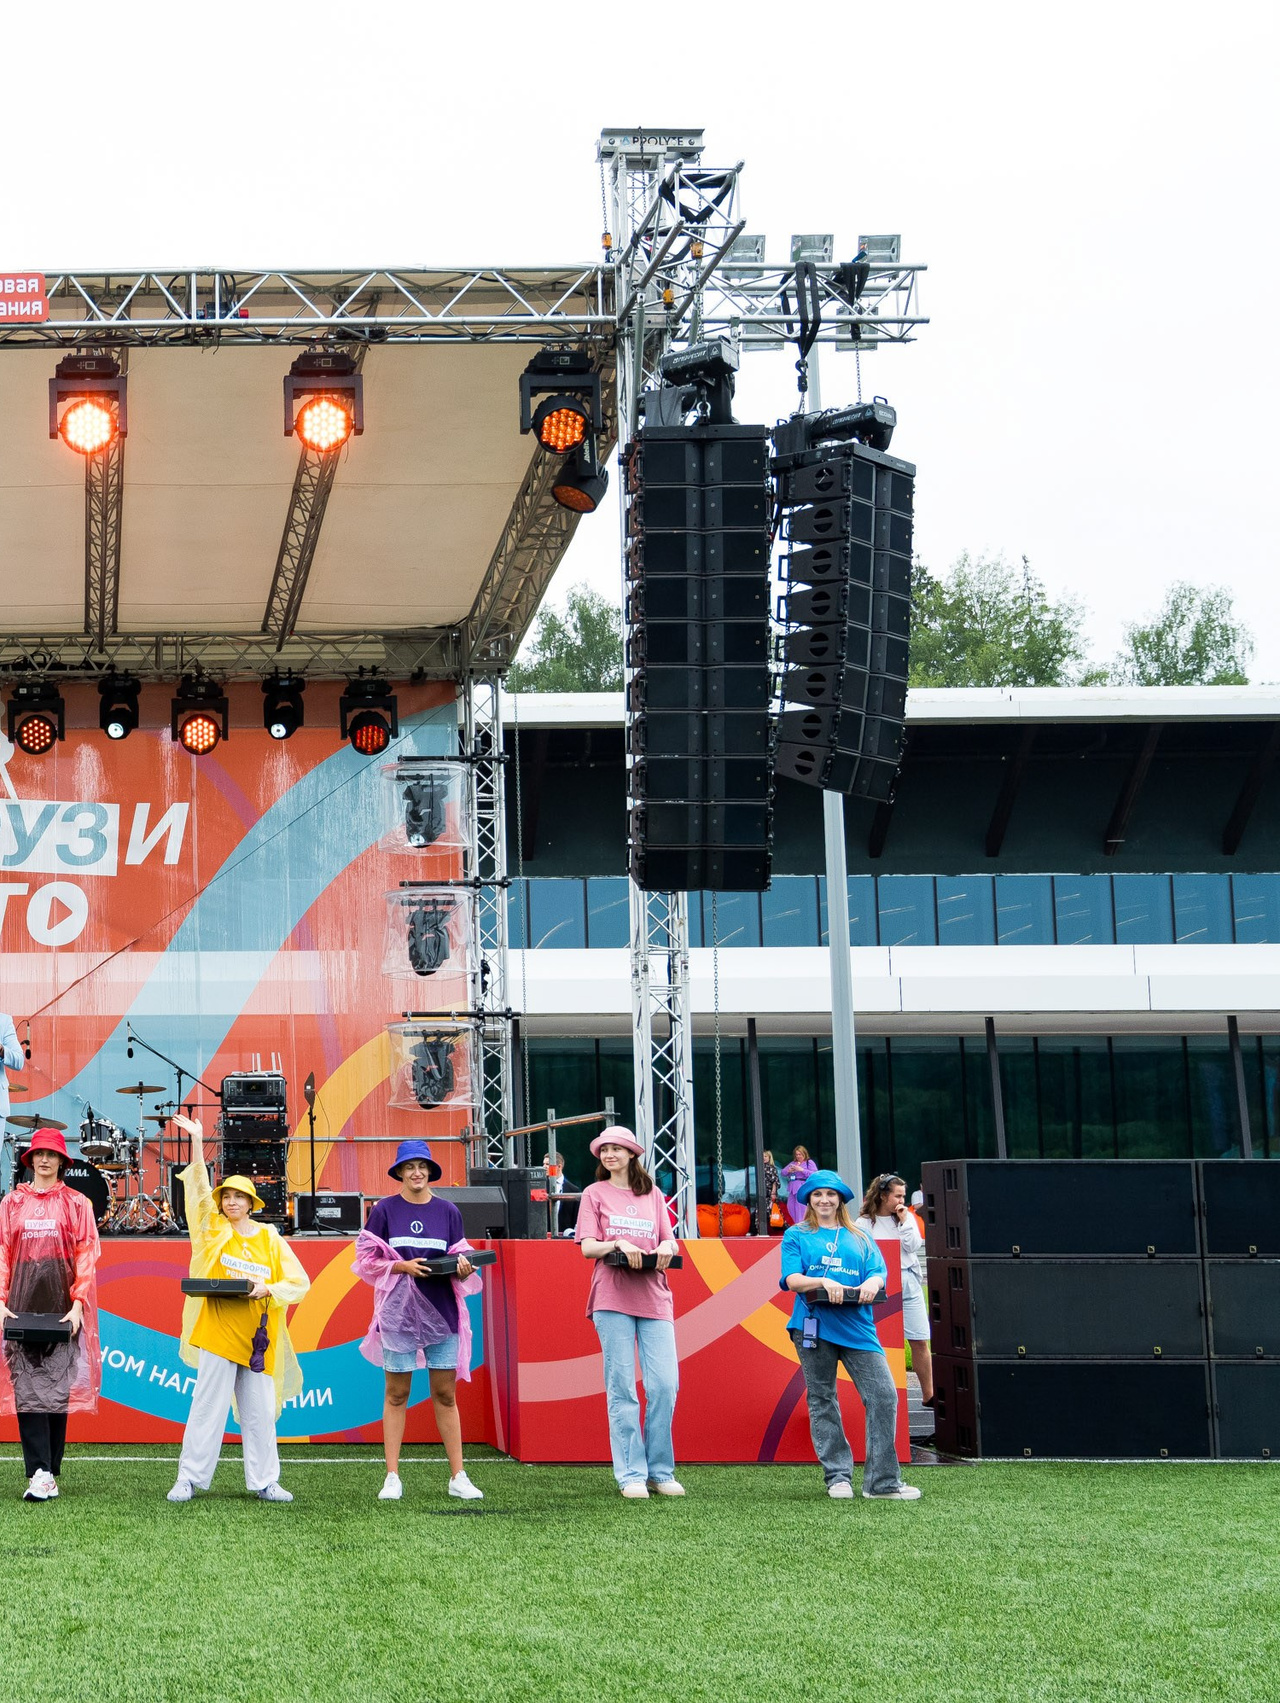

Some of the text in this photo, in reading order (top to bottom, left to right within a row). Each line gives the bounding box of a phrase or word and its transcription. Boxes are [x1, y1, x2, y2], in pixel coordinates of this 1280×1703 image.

[26, 1220, 55, 1229] ПУНКТ
[611, 1217, 653, 1229] СТАНЦИЯ
[22, 1230, 59, 1240] ДОВЕРИЯ
[605, 1228, 657, 1241] ТВОРЧЕСТВА
[221, 1256, 270, 1276] ПЛАТФОРМА
